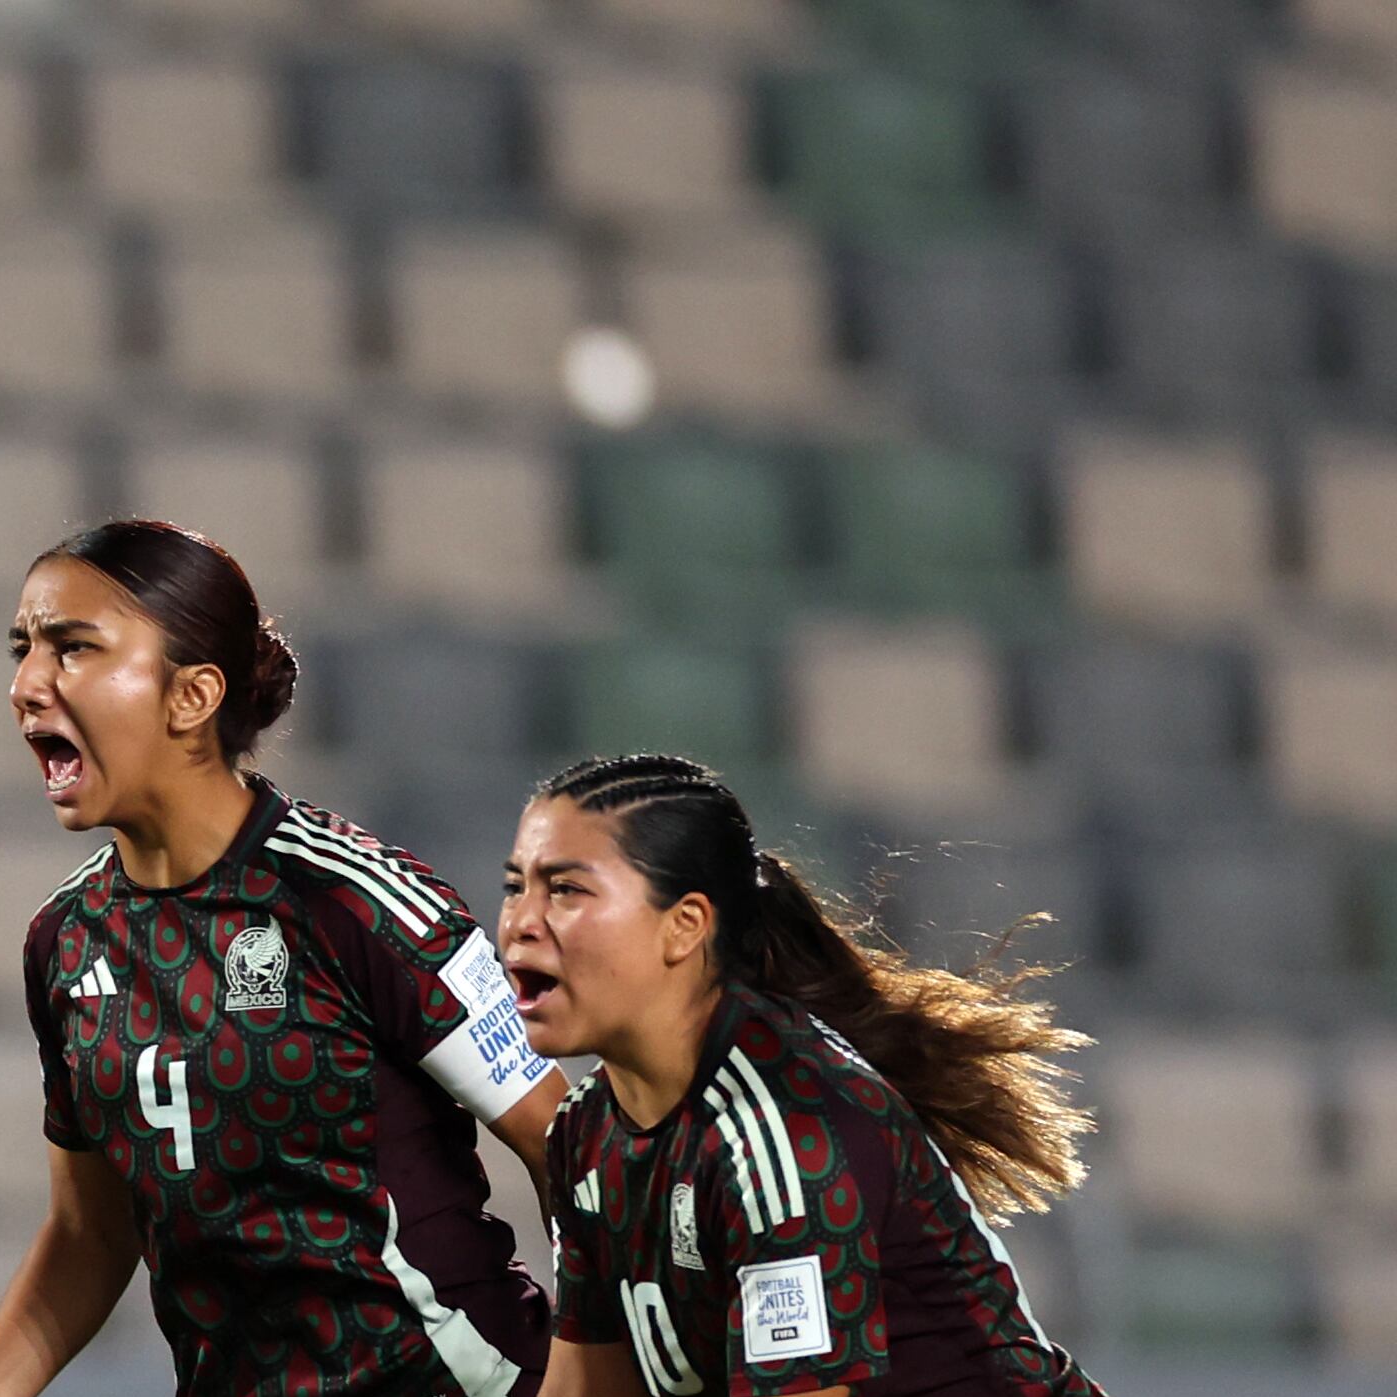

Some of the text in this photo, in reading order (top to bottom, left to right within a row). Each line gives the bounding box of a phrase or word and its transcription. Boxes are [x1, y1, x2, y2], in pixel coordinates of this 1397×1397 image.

[468, 993, 517, 1043] FOOTBA
[477, 1012, 524, 1063] UNIT
[136, 1045, 196, 1171] 4
[773, 1328, 797, 1340] FIFA
